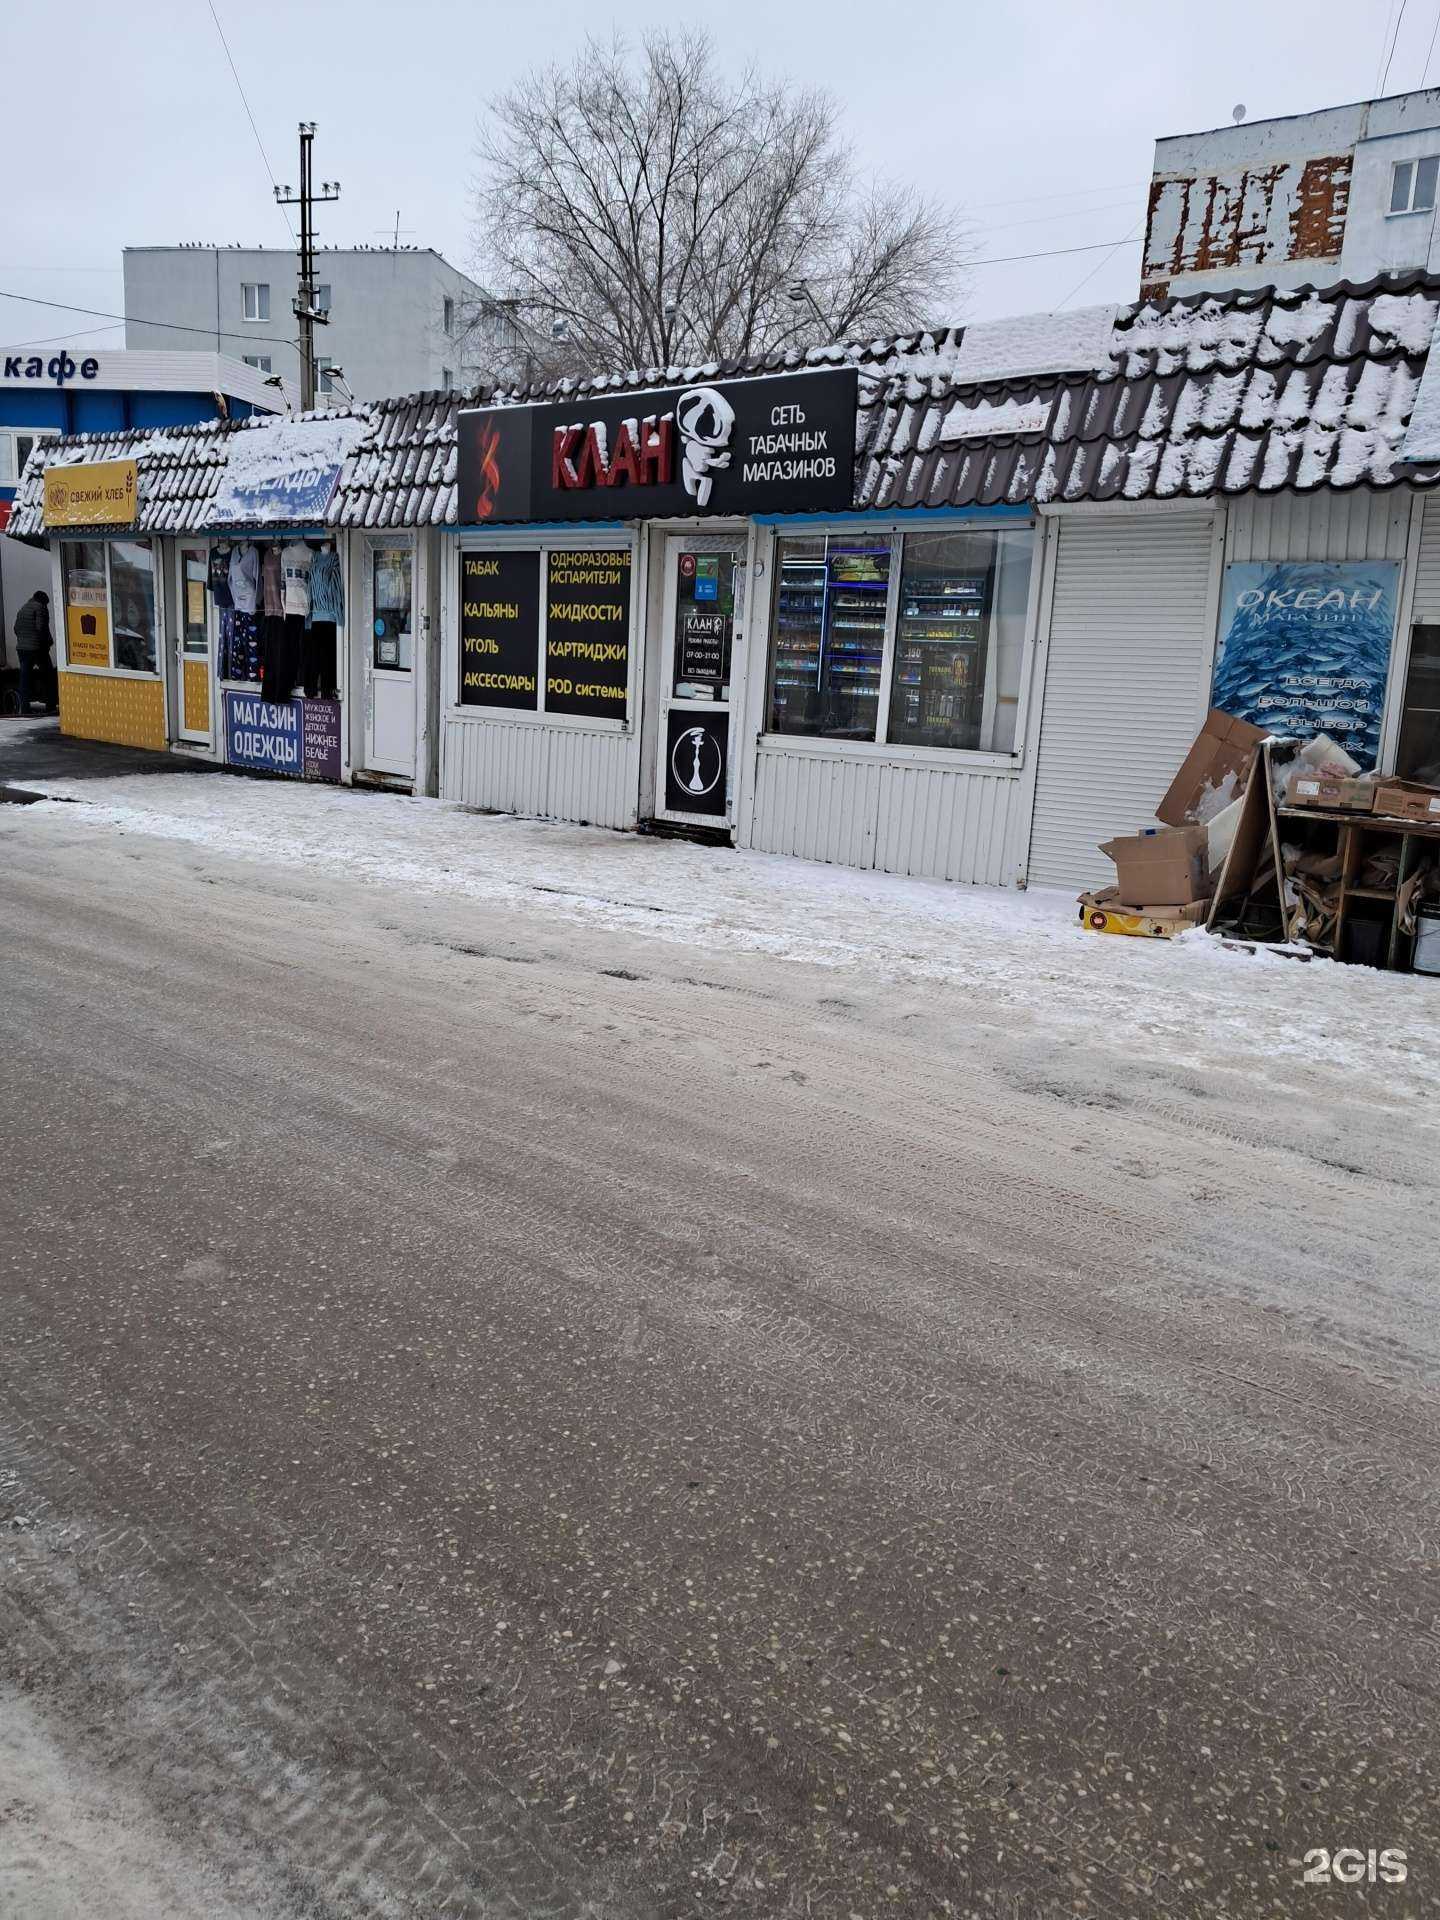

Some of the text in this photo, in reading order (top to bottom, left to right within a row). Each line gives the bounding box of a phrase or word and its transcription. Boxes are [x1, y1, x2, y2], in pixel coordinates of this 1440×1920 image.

[4, 350, 98, 386] кафе
[771, 404, 806, 426] СЕТЬ
[552, 412, 674, 489] КЛАН
[748, 430, 828, 455] ТАБАЧНЫХ
[743, 457, 836, 482] МАГАЗИНОВ
[70, 486, 124, 503] СВЕЖИЙ ХЛЕБ
[465, 560, 500, 575] ТАБАК
[550, 552, 632, 568] ОДНОРАЗОВЫЕ
[550, 570, 621, 585] ИСПАРИТЕЛИ
[1236, 588, 1383, 610] ОКЕАН
[464, 602, 519, 619] КАЛЬЯНЫ
[550, 603, 623, 621] ЖИДКОСТИ
[687, 617, 713, 630] КЛАН
[464, 638, 500, 654] УГОЛЬ
[548, 641, 627, 662] КАРТРИДЖИ
[464, 672, 536, 692] АКСЕССУАРЫ
[548, 678, 628, 699] POD системы
[1285, 676, 1372, 689] ВСЕГДА
[1257, 695, 1370, 711] БОЛЬШОЙ
[233, 700, 297, 732] МАГАЗИН
[1286, 717, 1368, 730] ВЫБОР
[304, 723, 328, 733] ДЕТСКОЕ
[234, 730, 297, 765] ОДЕЖДЫ
[305, 733, 338, 748] НИЖНЕЕ
